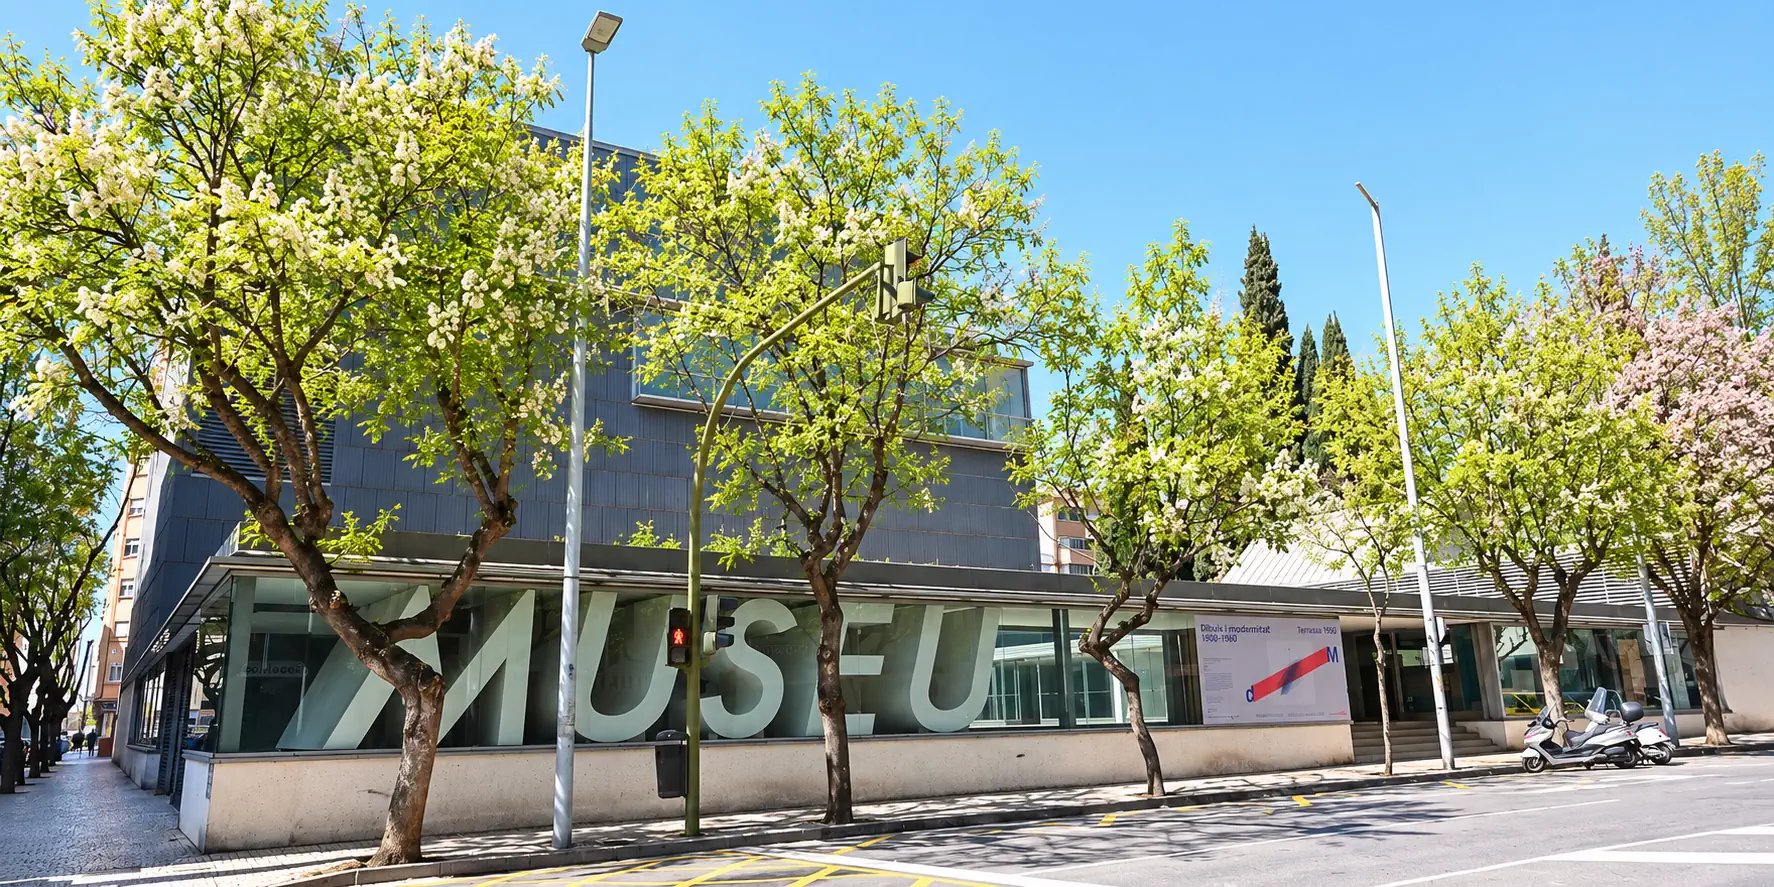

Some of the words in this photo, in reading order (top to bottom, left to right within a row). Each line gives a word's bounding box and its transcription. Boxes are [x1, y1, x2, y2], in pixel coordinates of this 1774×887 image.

[1326, 646, 1339, 662] M
[277, 585, 1000, 750] MUSEU
[1246, 685, 1254, 702] d
